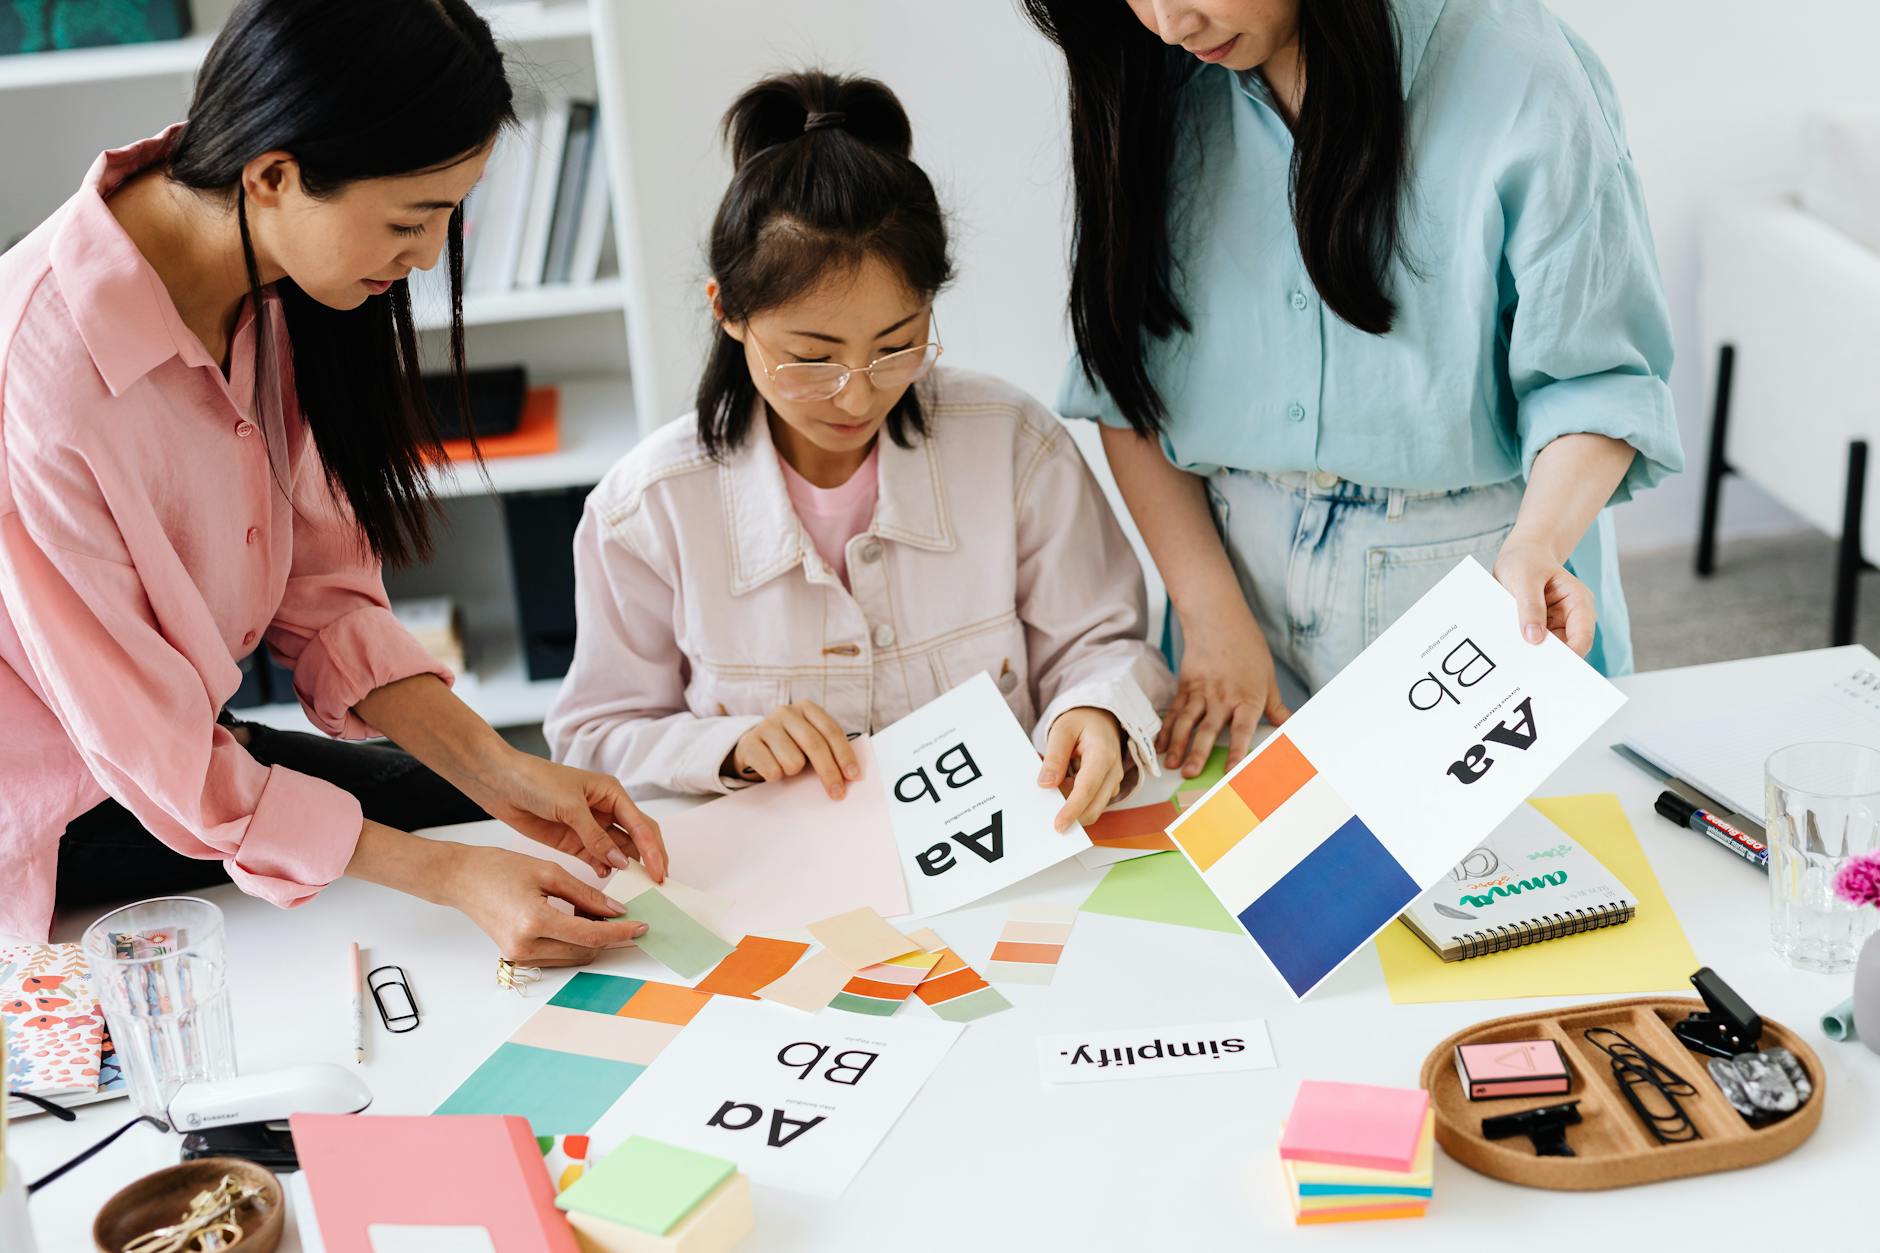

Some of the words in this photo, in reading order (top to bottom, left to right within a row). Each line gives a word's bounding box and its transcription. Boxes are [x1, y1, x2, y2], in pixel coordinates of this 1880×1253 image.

[1409, 638, 1496, 711] Bb
[1447, 697, 1537, 785] Aa
[895, 743, 982, 804] Bb
[916, 810, 1004, 877] Aa
[778, 1042, 878, 1085] Bb
[1061, 1039, 1246, 1068] simplify.
[707, 1101, 827, 1148] Aa
